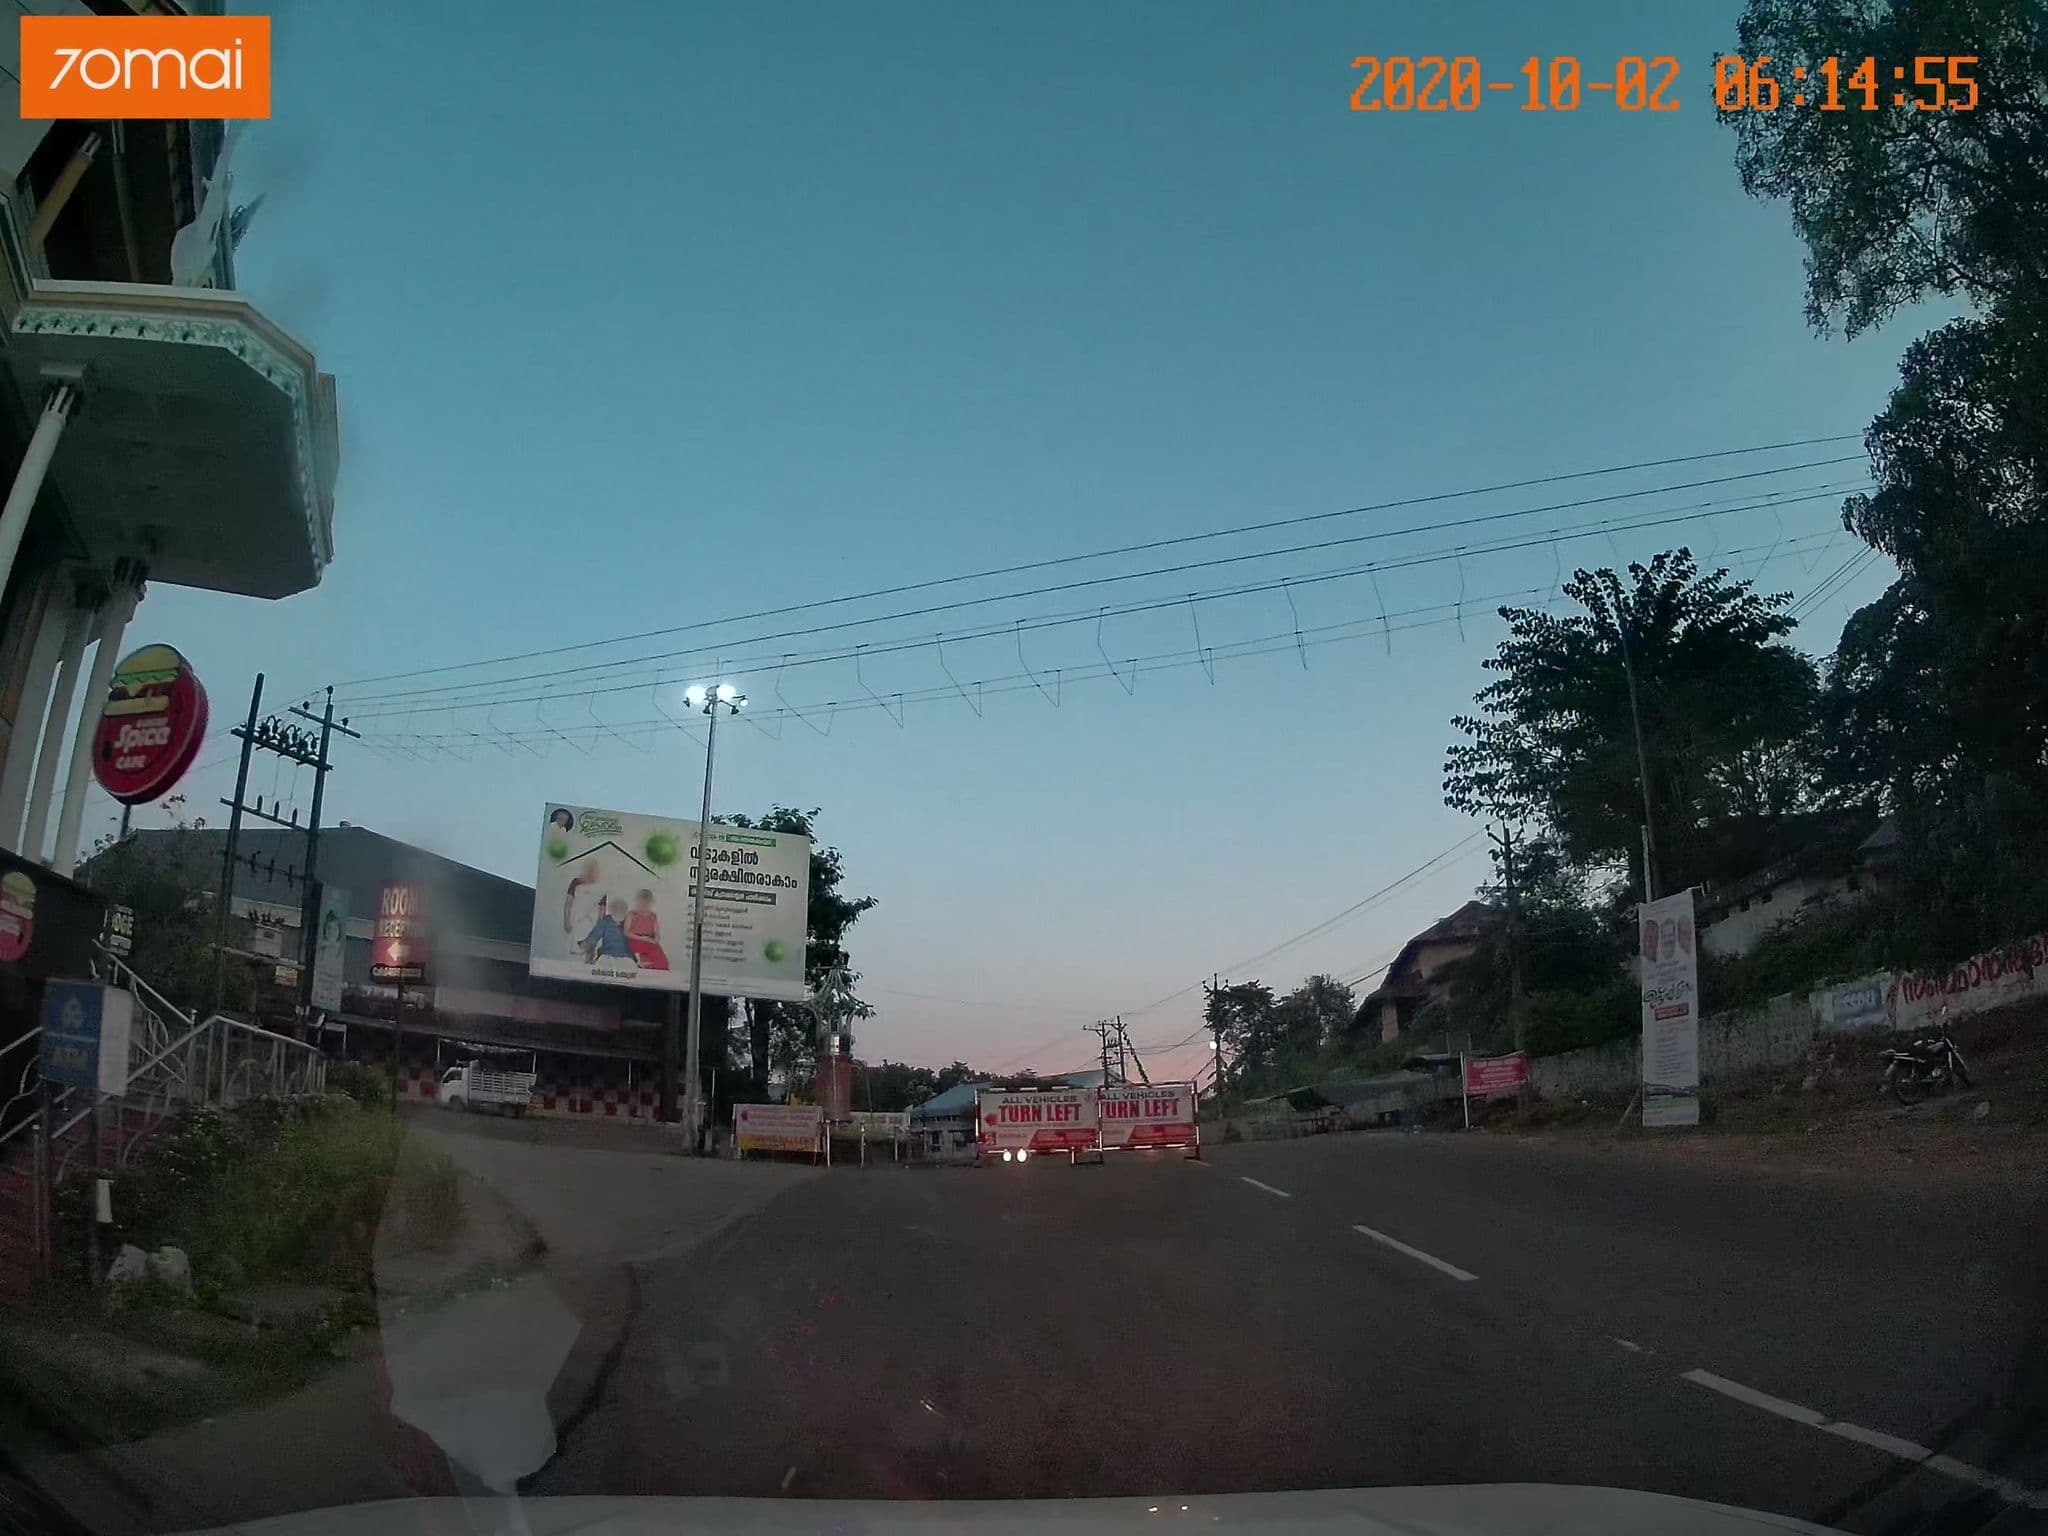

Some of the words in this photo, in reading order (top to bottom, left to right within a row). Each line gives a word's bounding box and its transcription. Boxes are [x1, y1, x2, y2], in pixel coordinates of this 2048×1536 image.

[690, 844, 759, 866] വടുകളിൽ
[1003, 1096, 1022, 1104] ALL
[1024, 1095, 1078, 1104] VEHICLES
[1122, 1091, 1175, 1100] VEHICLES
[998, 1104, 1042, 1122] TURN
[1046, 1103, 1082, 1121] LEFT
[1144, 1098, 1179, 1117] LEFT
